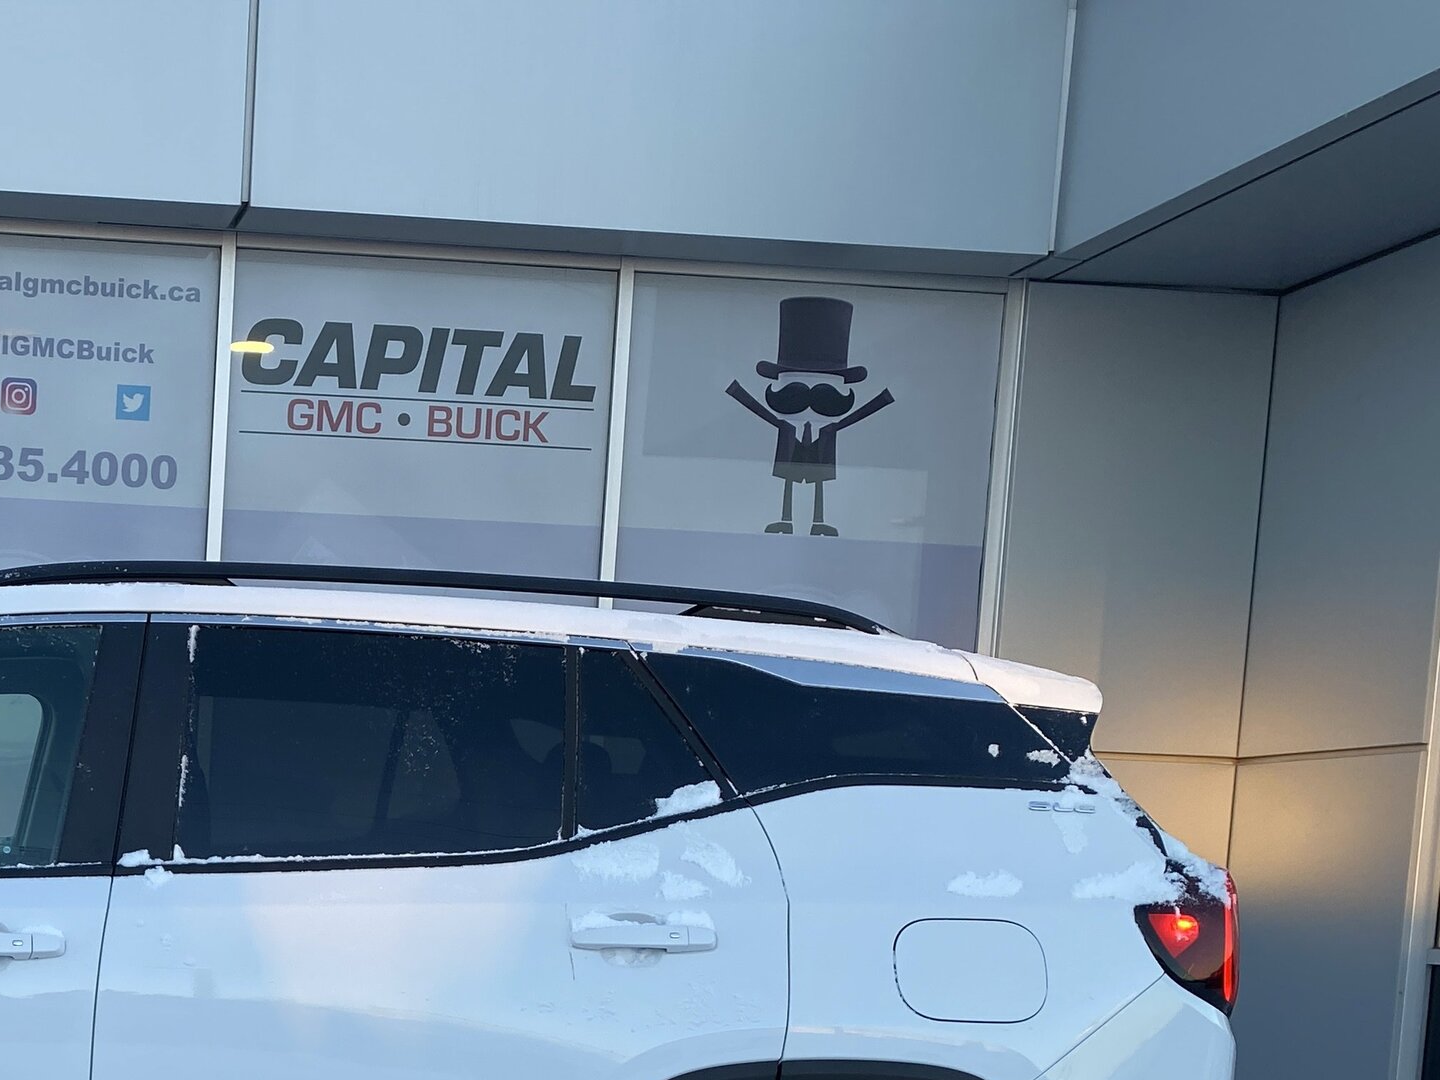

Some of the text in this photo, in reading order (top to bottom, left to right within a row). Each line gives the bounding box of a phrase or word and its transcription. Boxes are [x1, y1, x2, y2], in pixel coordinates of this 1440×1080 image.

[241, 317, 597, 402] CAPITAL
[286, 398, 550, 444] GMC BUICK
